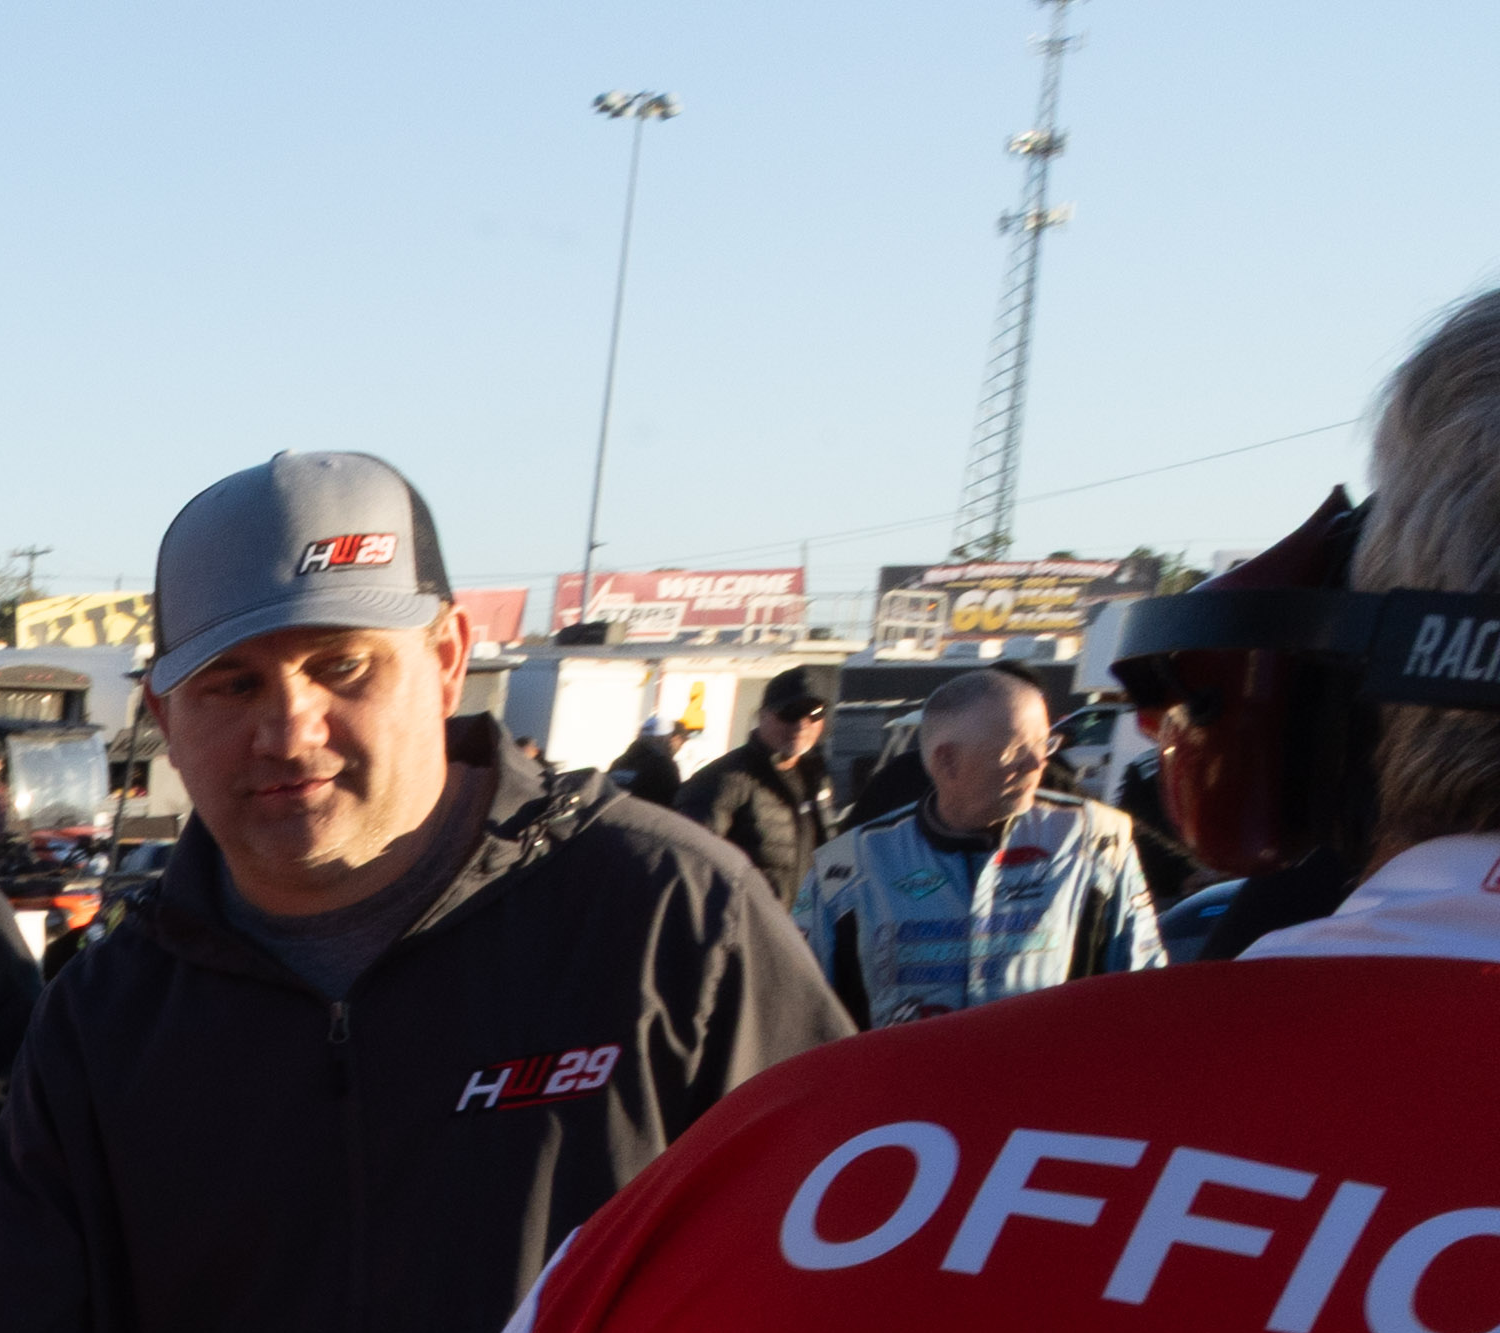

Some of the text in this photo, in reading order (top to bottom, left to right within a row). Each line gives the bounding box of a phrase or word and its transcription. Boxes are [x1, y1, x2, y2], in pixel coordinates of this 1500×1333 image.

[300, 533, 397, 574] HW29
[657, 573, 797, 600] WELCOME
[952, 588, 1013, 631] 60
[455, 1045, 620, 1112] HW29
